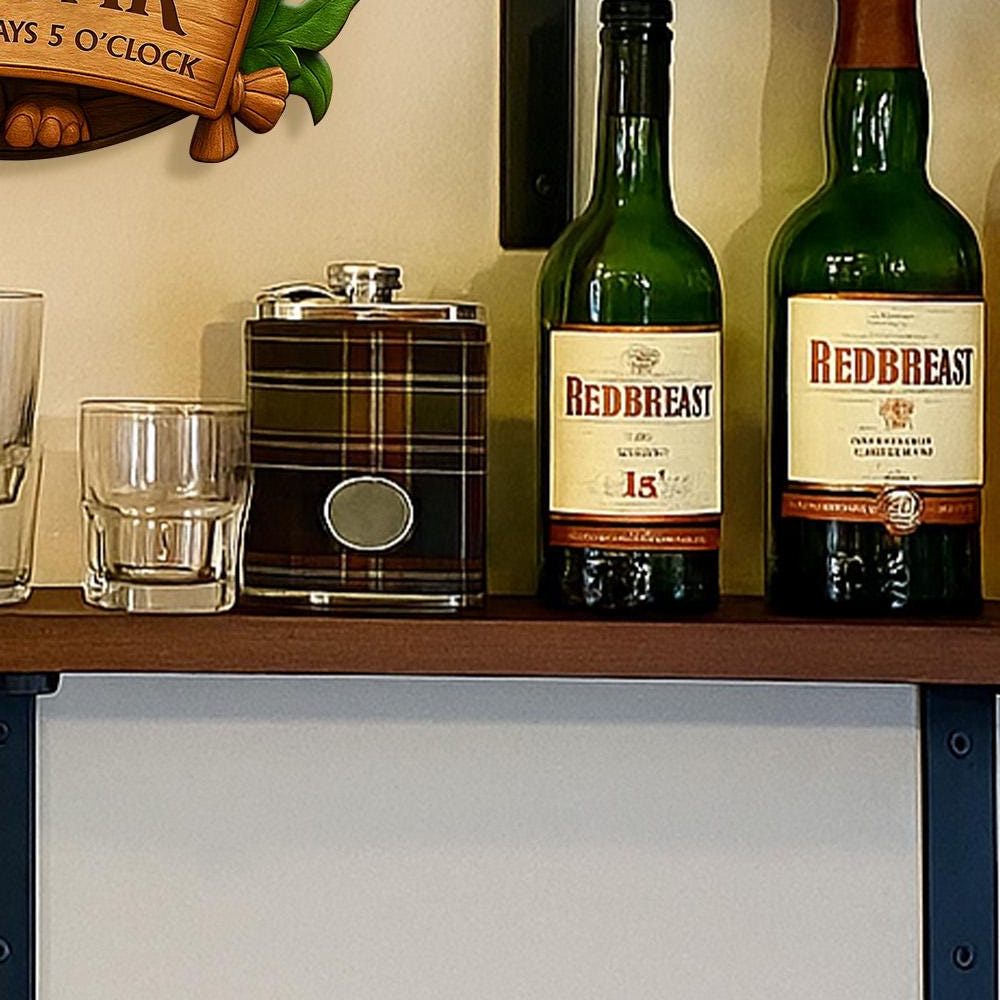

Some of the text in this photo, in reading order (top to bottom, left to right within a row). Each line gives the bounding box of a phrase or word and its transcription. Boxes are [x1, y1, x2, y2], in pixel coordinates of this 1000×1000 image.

[50, 24, 64, 47] 5
[74, 29, 202, 81] O'CLOCK
[807, 339, 974, 386] REDBREAST
[566, 375, 713, 417] REDBREAST
